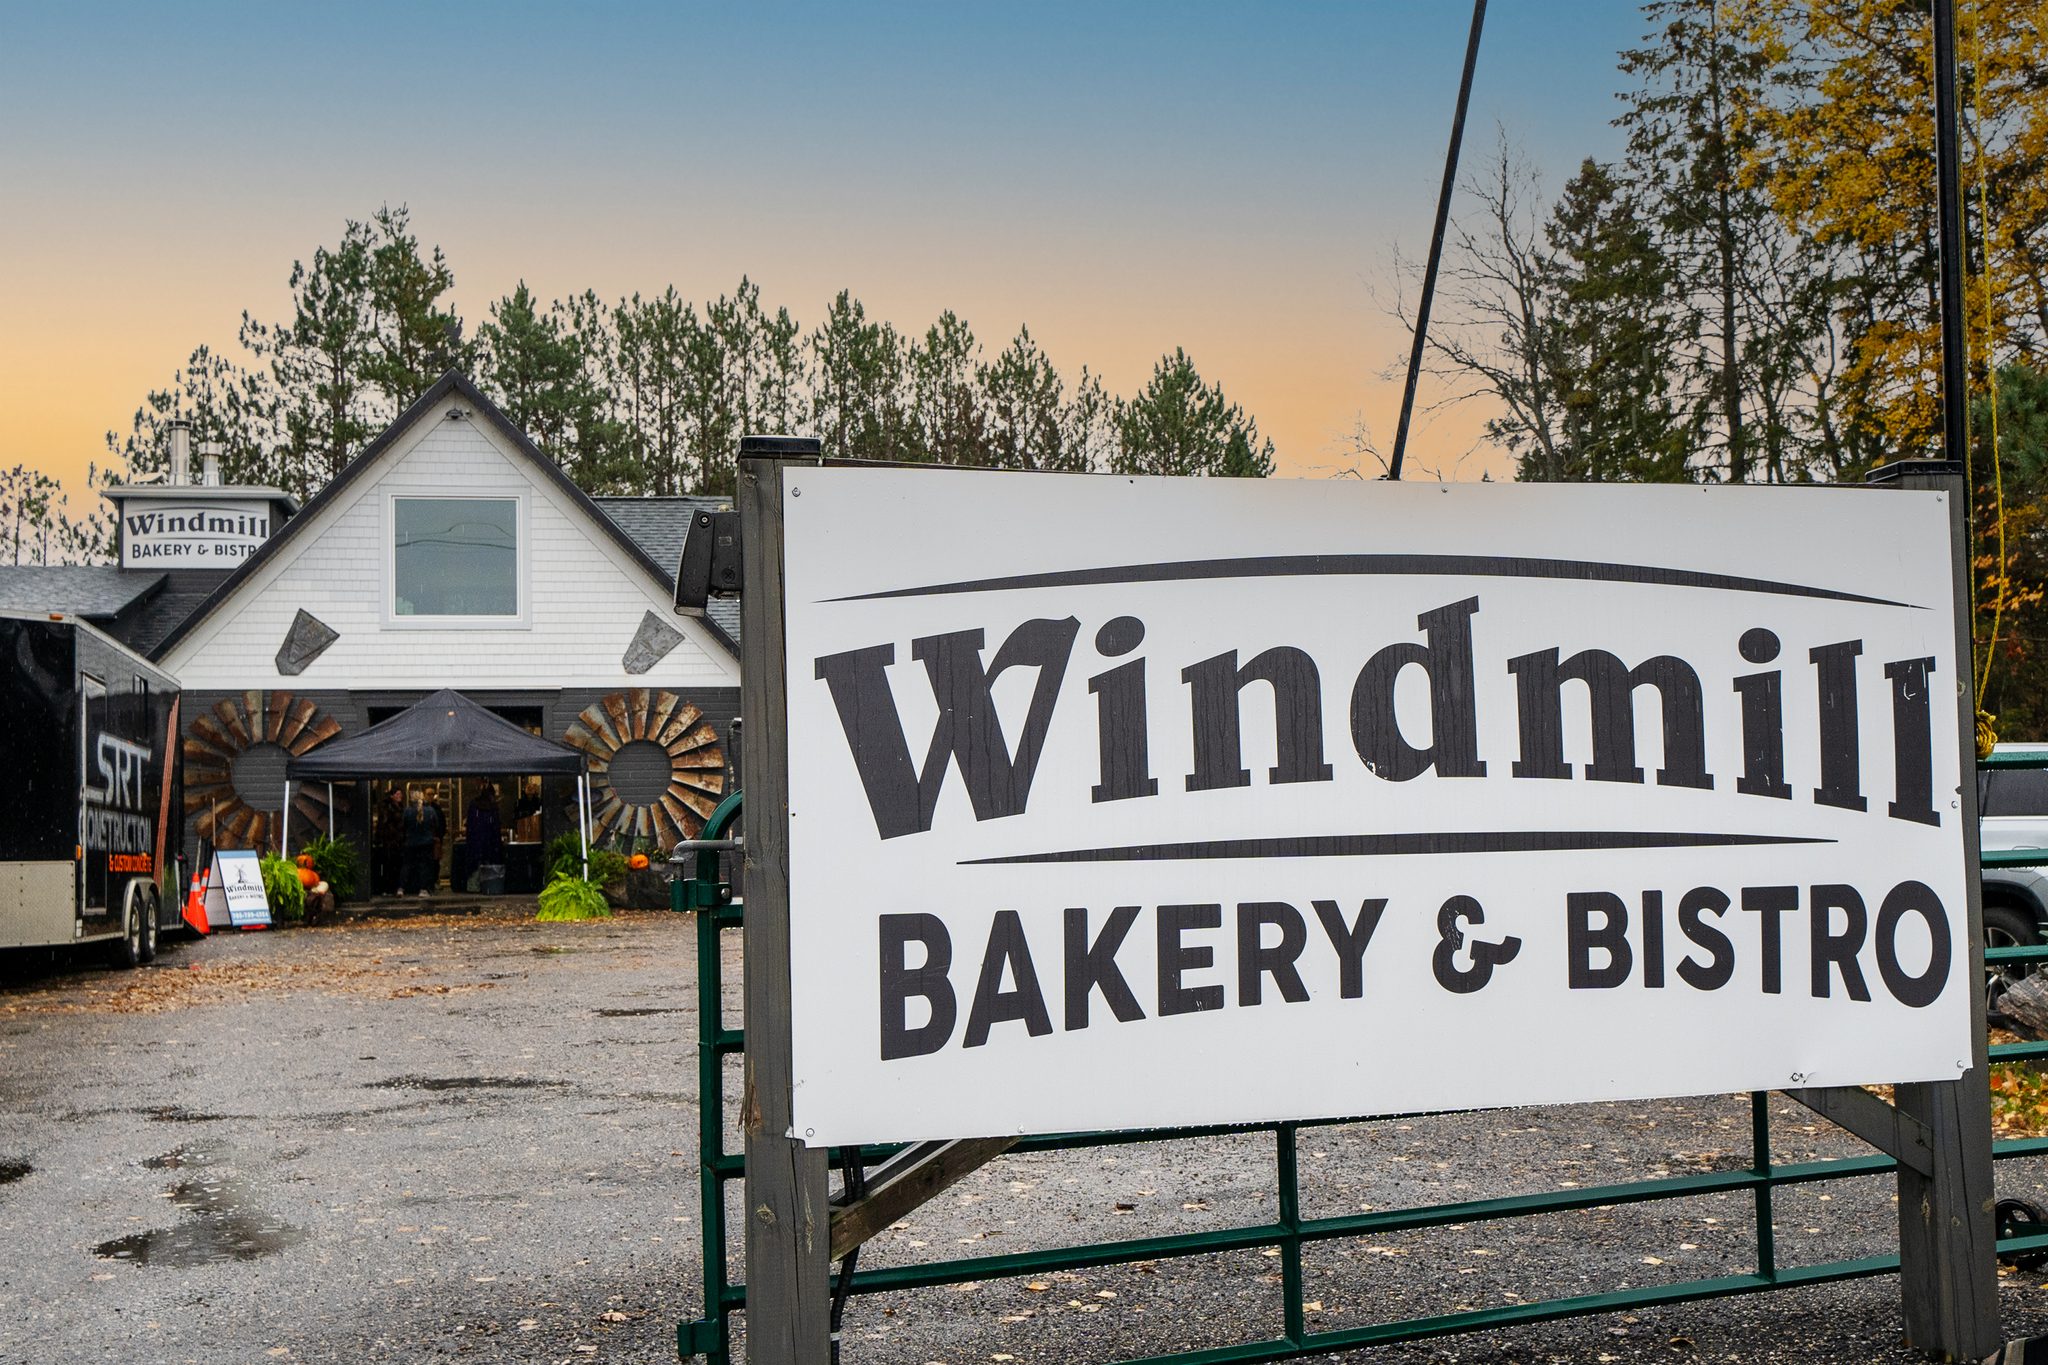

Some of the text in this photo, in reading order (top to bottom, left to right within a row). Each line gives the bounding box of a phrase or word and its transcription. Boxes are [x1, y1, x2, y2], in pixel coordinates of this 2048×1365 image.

[126, 512, 267, 539] Windmill
[132, 544, 258, 559] BAKERY & BISTR
[815, 596, 1941, 841] Windmill
[80, 731, 152, 811] SRT
[109, 853, 114, 872] &
[226, 884, 263, 894] Windmill
[879, 881, 1952, 1062] BAKERY & BISTRO
